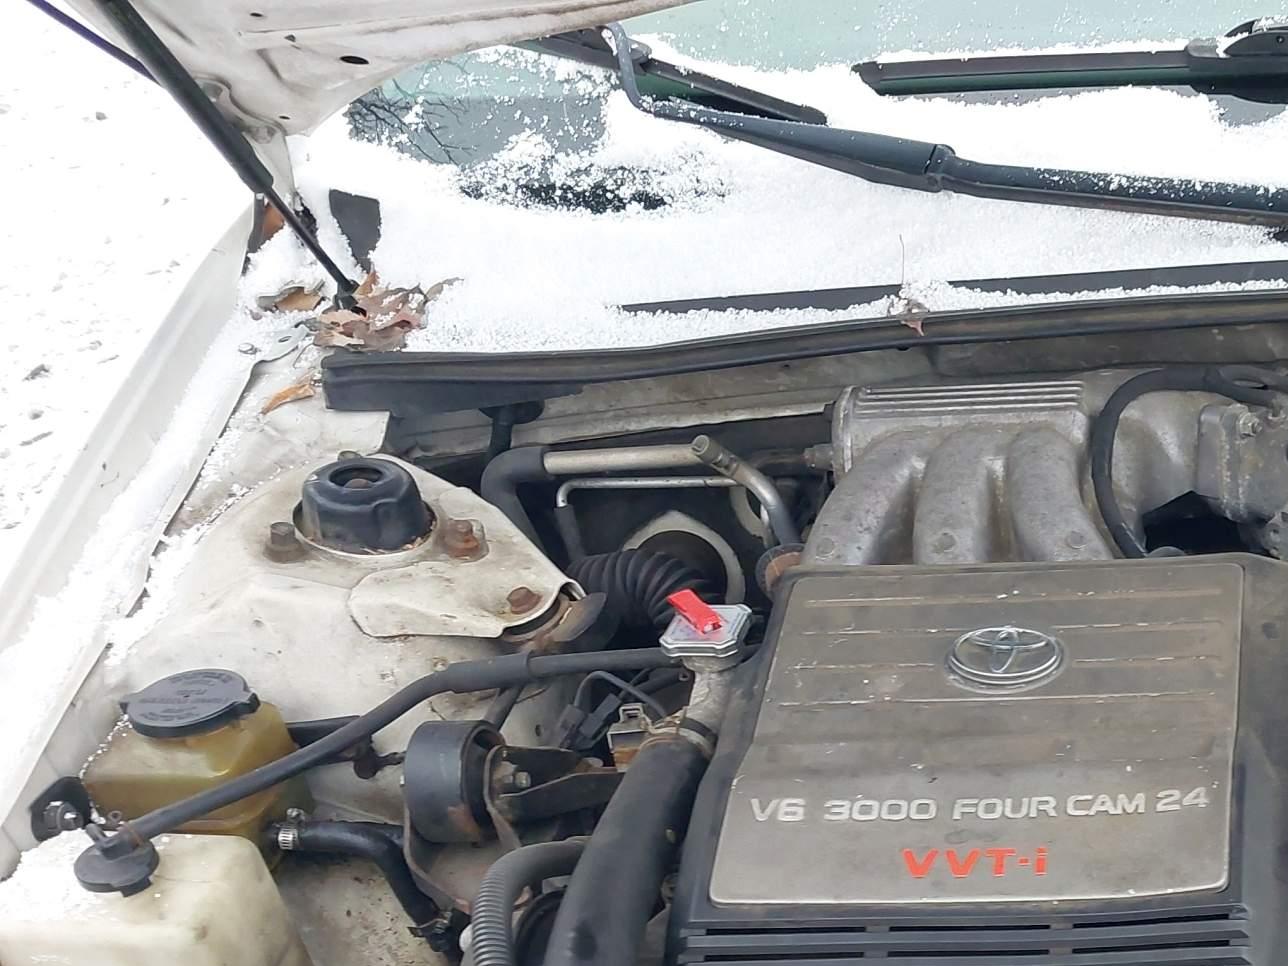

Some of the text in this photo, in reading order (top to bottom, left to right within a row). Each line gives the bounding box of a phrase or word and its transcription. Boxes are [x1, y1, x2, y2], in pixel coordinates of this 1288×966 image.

[751, 787, 1209, 821] V6 3000 FOUR CAM 24
[902, 847, 1048, 878] VVT-i
